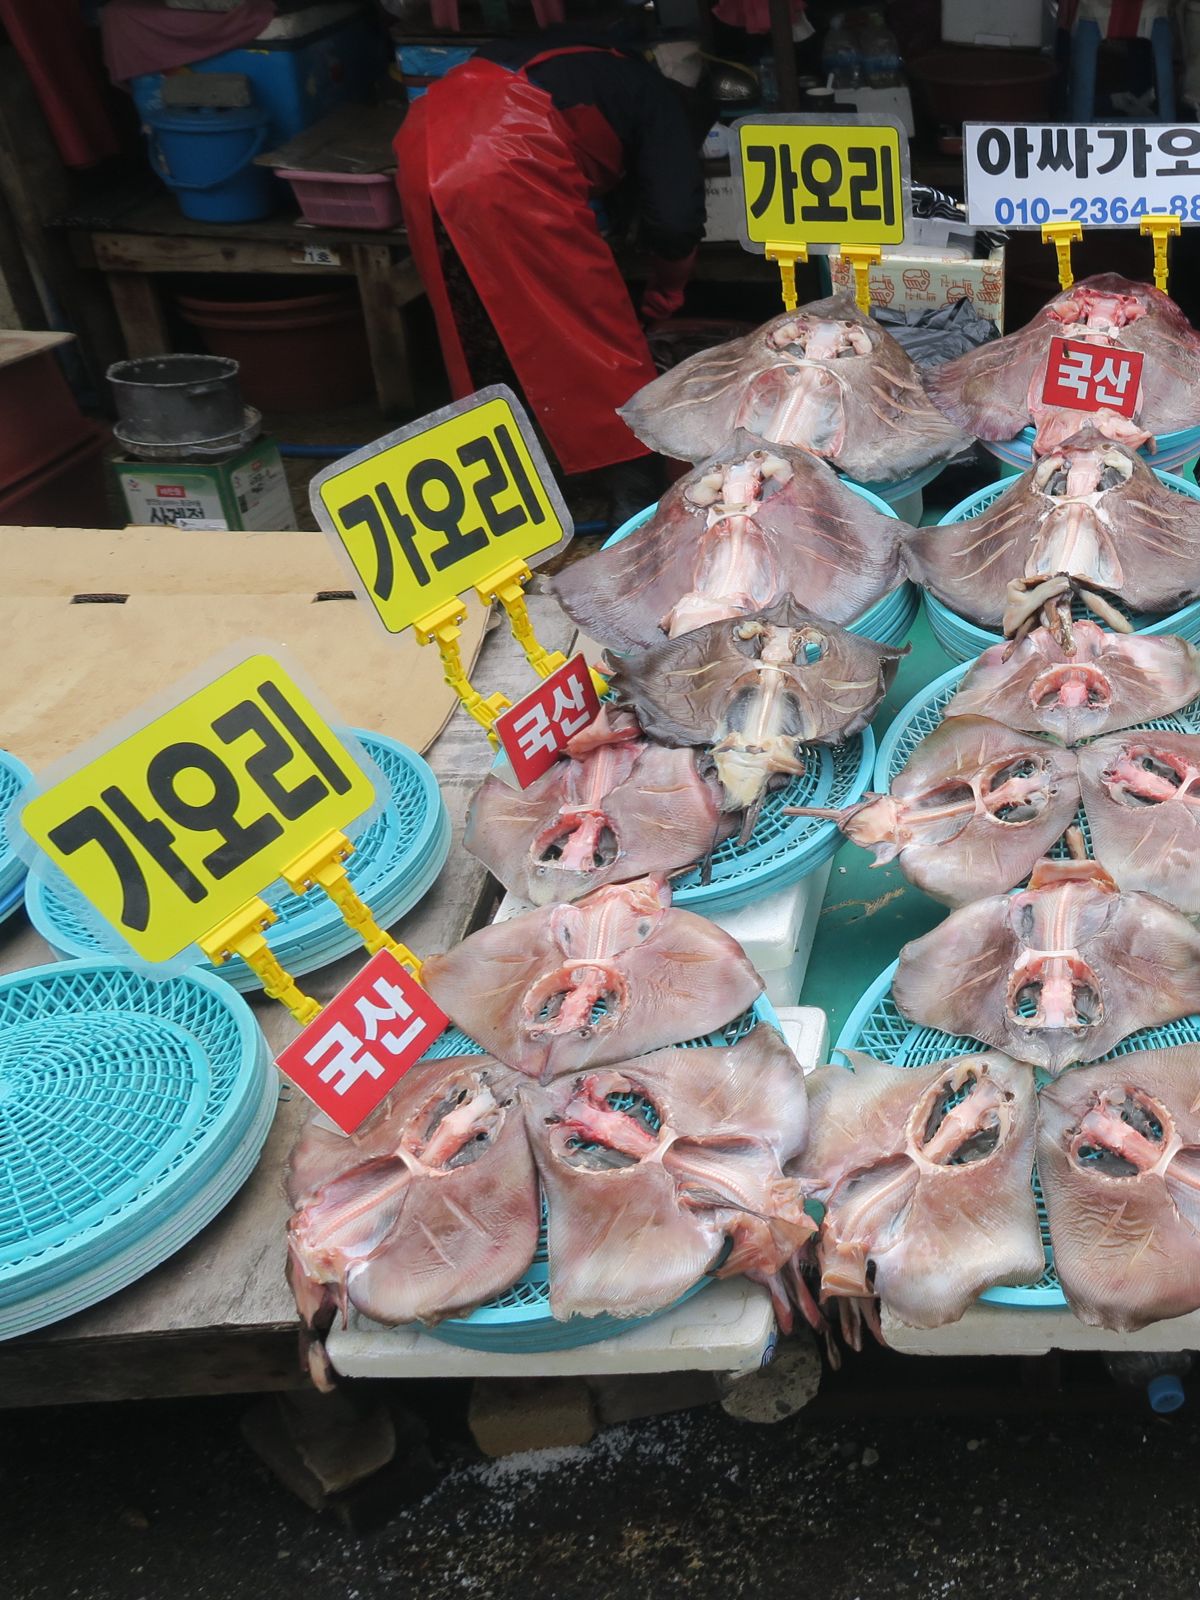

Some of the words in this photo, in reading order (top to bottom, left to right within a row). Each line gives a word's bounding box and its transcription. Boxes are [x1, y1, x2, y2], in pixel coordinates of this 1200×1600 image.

[746, 144, 896, 226] 가오리
[1057, 351, 1132, 406] 국산
[338, 423, 546, 602] 가오리
[513, 674, 593, 760] 국산
[47, 680, 352, 932] 가오리
[303, 976, 427, 1096] 국산
